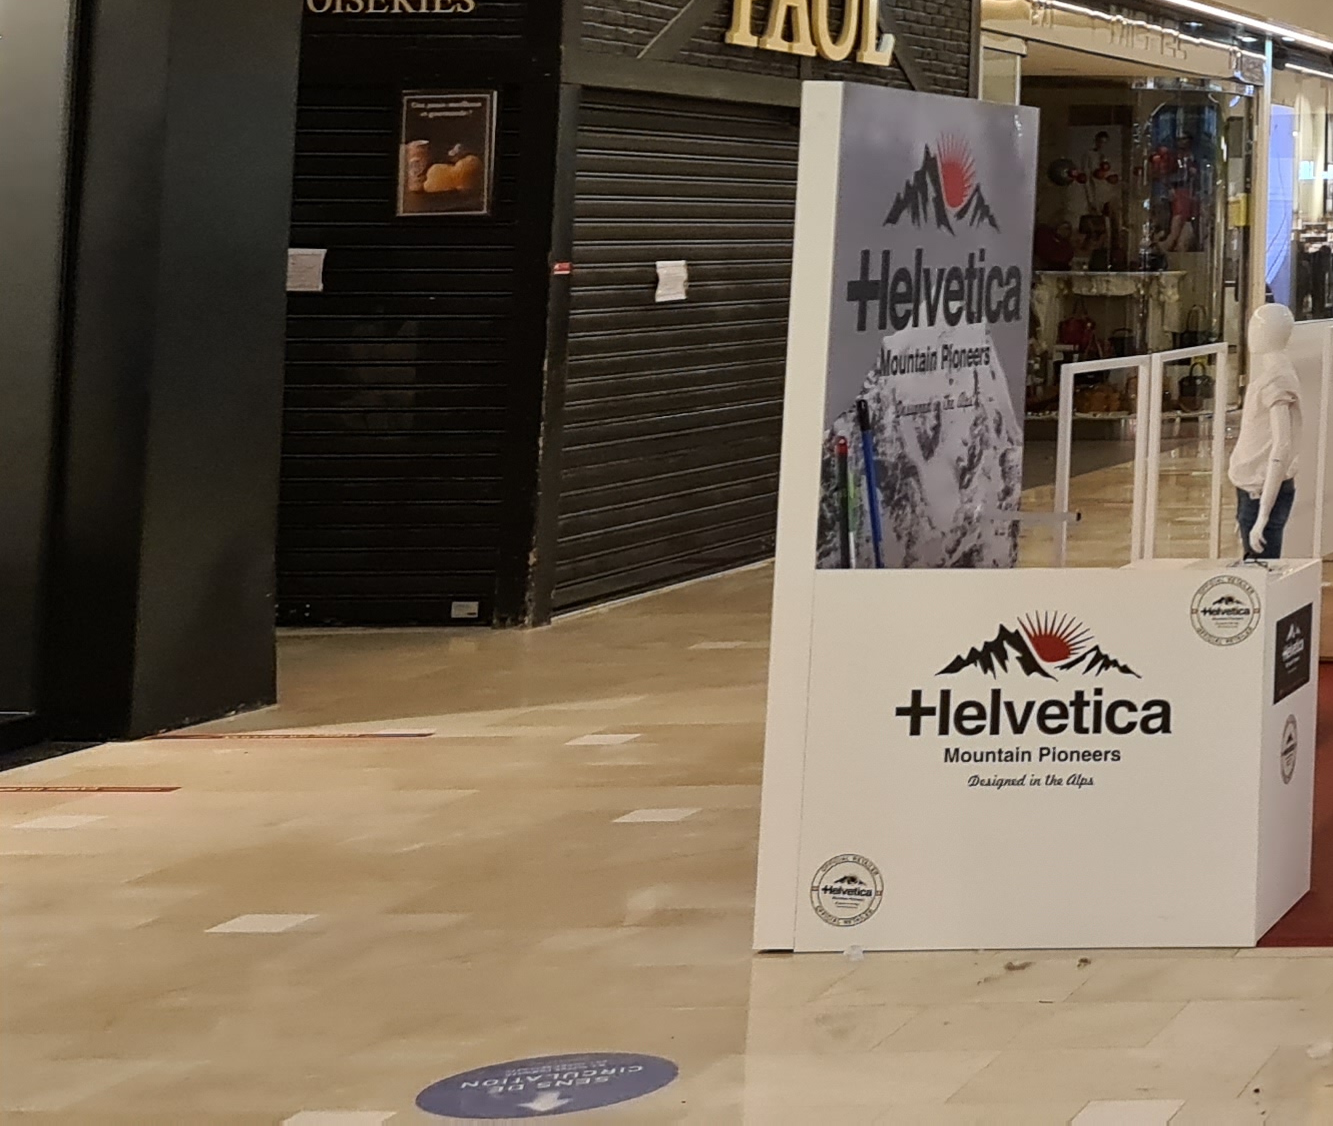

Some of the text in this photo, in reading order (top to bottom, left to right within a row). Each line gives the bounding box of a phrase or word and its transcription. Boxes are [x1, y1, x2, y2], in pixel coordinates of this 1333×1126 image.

[846, 248, 1022, 331] Helvetica
[879, 343, 990, 376] Mountain Pioneers
[1200, 607, 1251, 617] Helvetica
[895, 687, 1172, 736] Helvetica
[943, 747, 1121, 763] Mountain Pioneers
[967, 773, 1095, 790] Designed in the Alps
[821, 884, 873, 897] Helvetica
[460, 1064, 644, 1089] CIRCULATION
[536, 1075, 609, 1088] SENS
